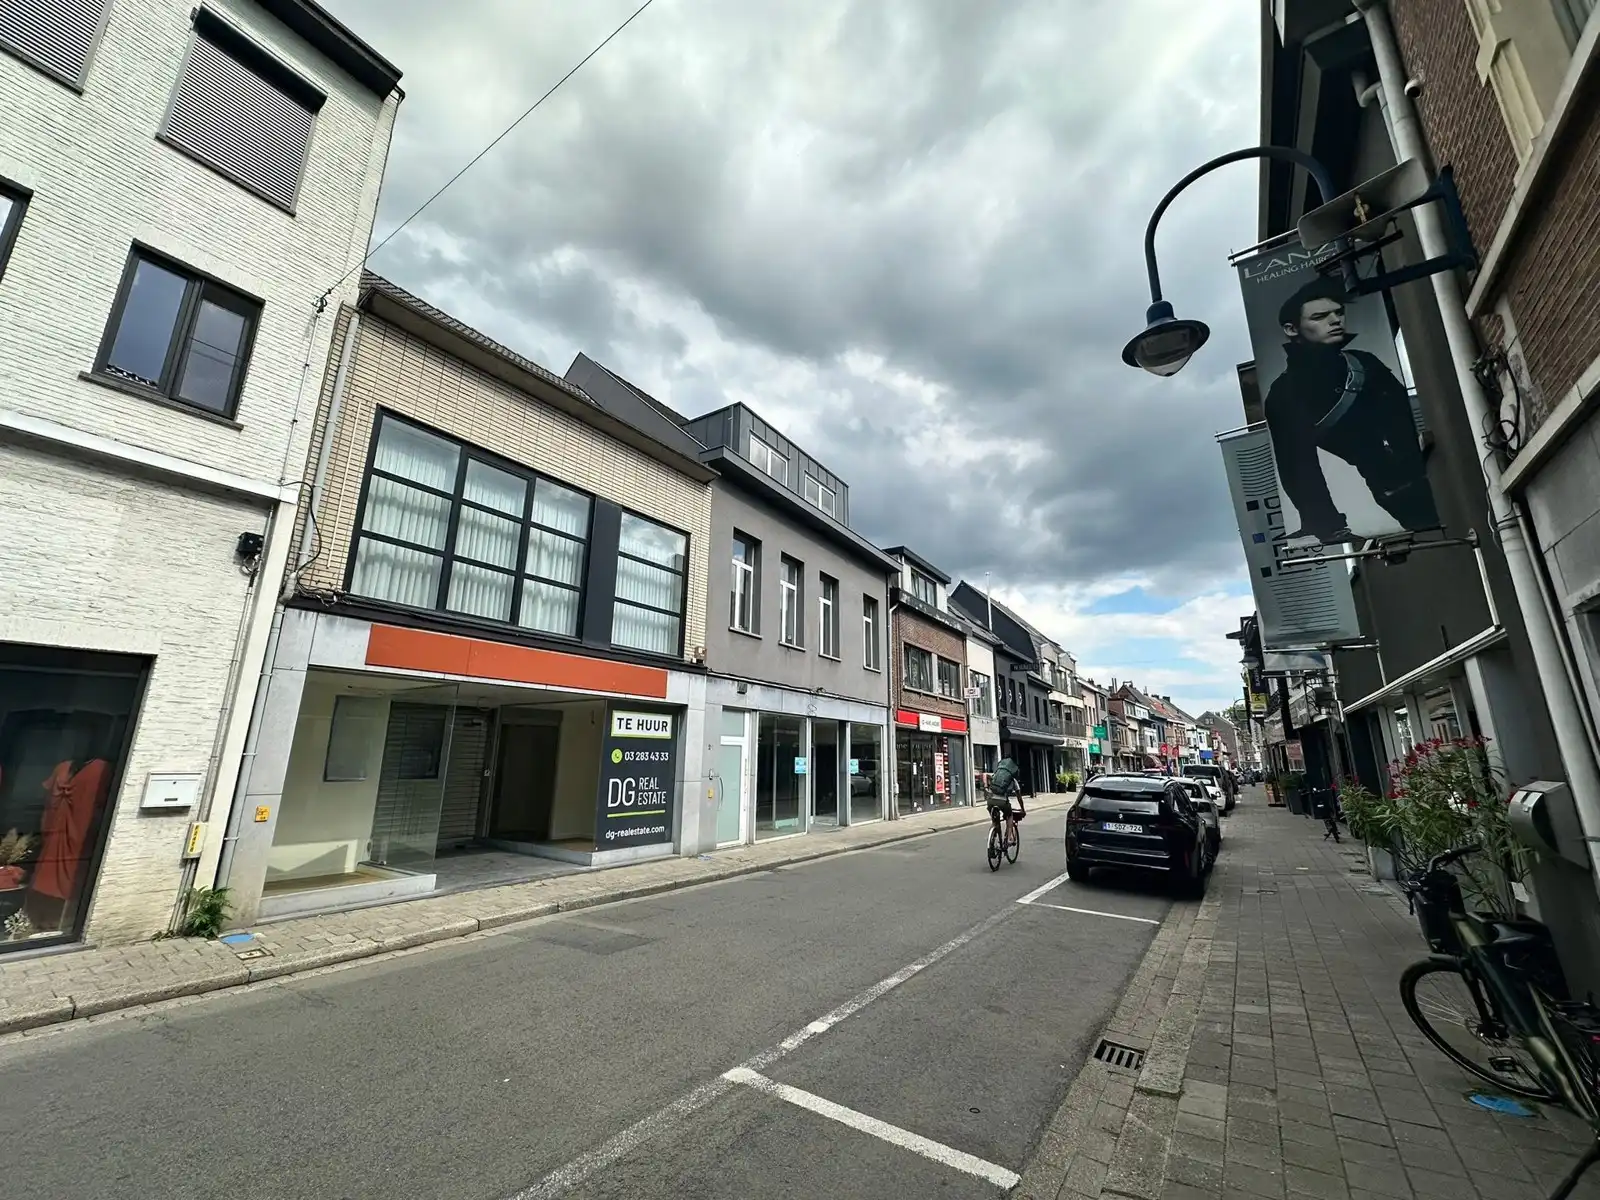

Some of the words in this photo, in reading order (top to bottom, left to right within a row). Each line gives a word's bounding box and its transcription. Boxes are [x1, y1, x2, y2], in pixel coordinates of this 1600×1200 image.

[1256, 264, 1299, 284] HEALING
[617, 717, 632, 730] TE
[637, 718, 668, 732] HUUR
[624, 751, 635, 761] 03
[635, 751, 649, 761] 283
[650, 751, 660, 761] 43
[660, 751, 669, 761] 33
[638, 777, 659, 790] REAL
[607, 777, 636, 808] DG
[637, 791, 667, 806] ESTATE
[605, 825, 665, 841] dg-realestate.com
